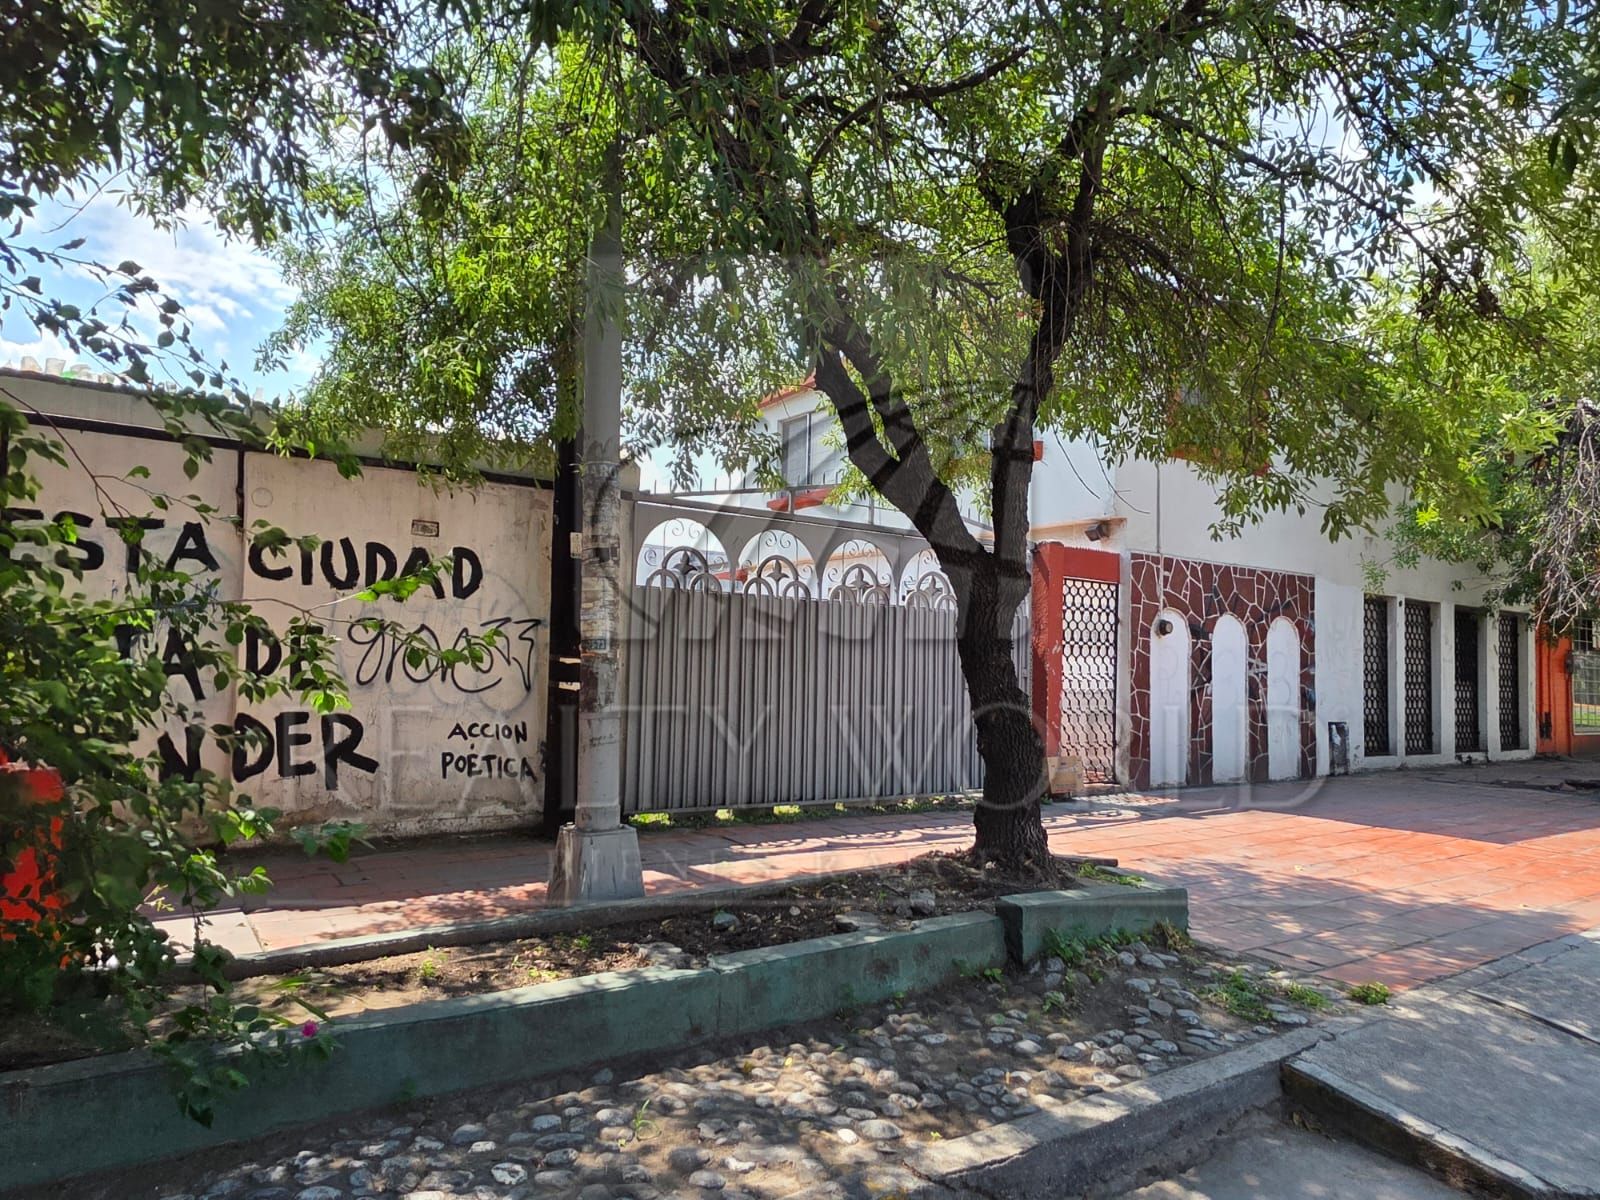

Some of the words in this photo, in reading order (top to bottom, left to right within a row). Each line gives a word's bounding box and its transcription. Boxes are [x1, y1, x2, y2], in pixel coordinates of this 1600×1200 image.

[248, 537, 483, 601] CIUDAD
[245, 623, 334, 691] DE
[447, 720, 528, 743] ACCION
[440, 743, 538, 783] POÉTICA
